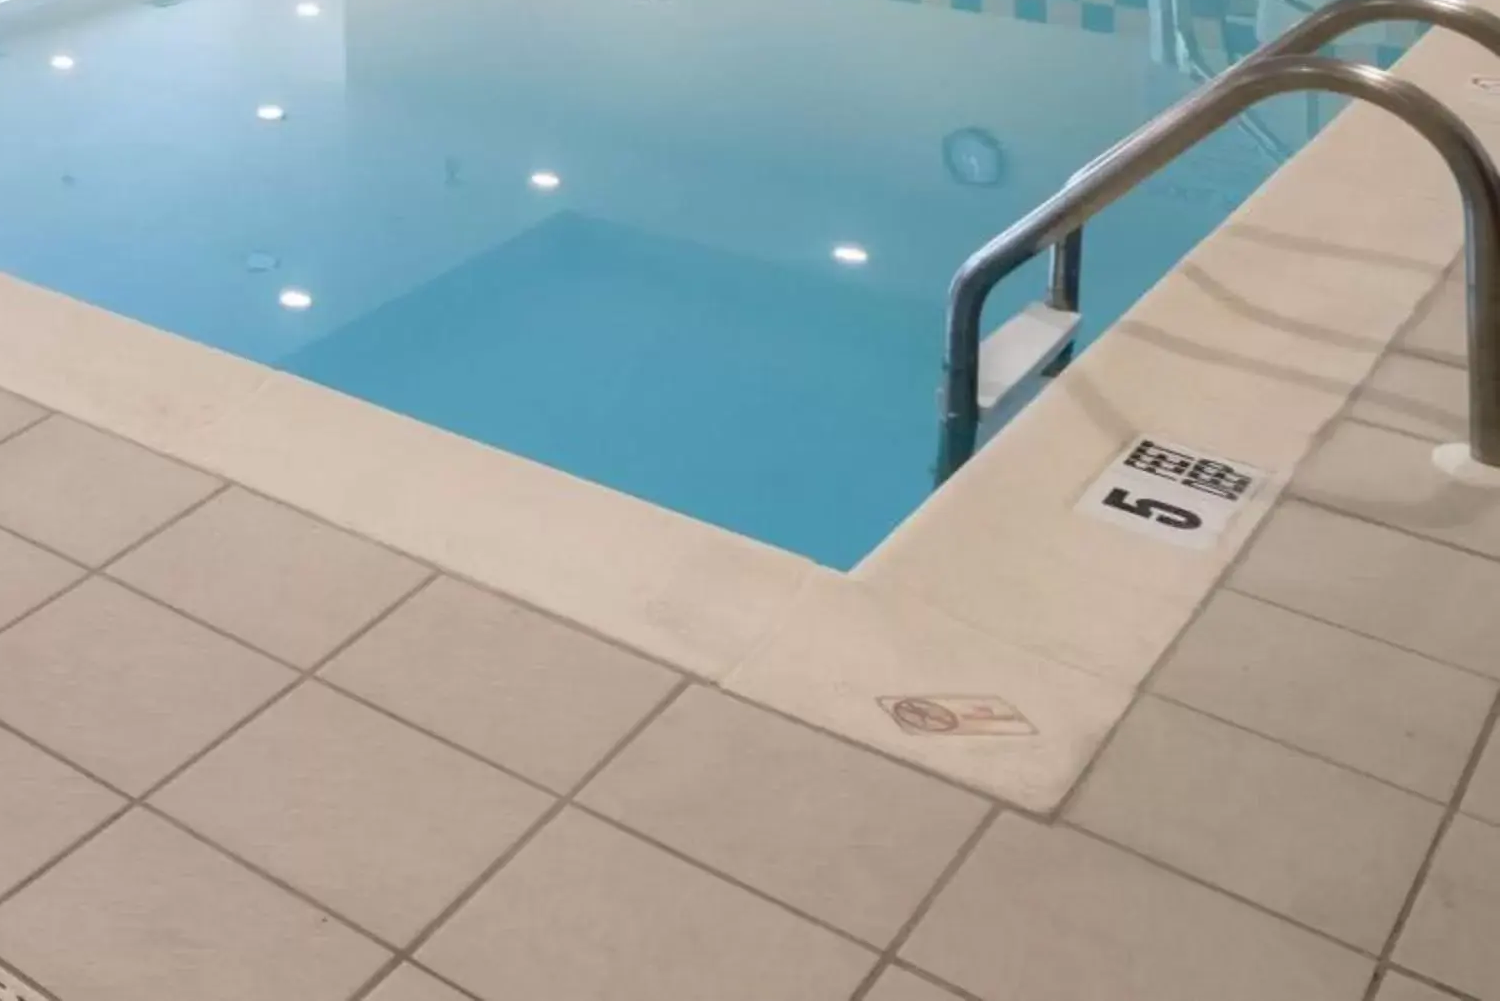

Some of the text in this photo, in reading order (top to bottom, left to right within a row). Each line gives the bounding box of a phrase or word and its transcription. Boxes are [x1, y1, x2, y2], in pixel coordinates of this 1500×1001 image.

[1123, 439, 1195, 481] FEET
[1181, 458, 1252, 501] DEEP
[1101, 487, 1202, 530] 5
